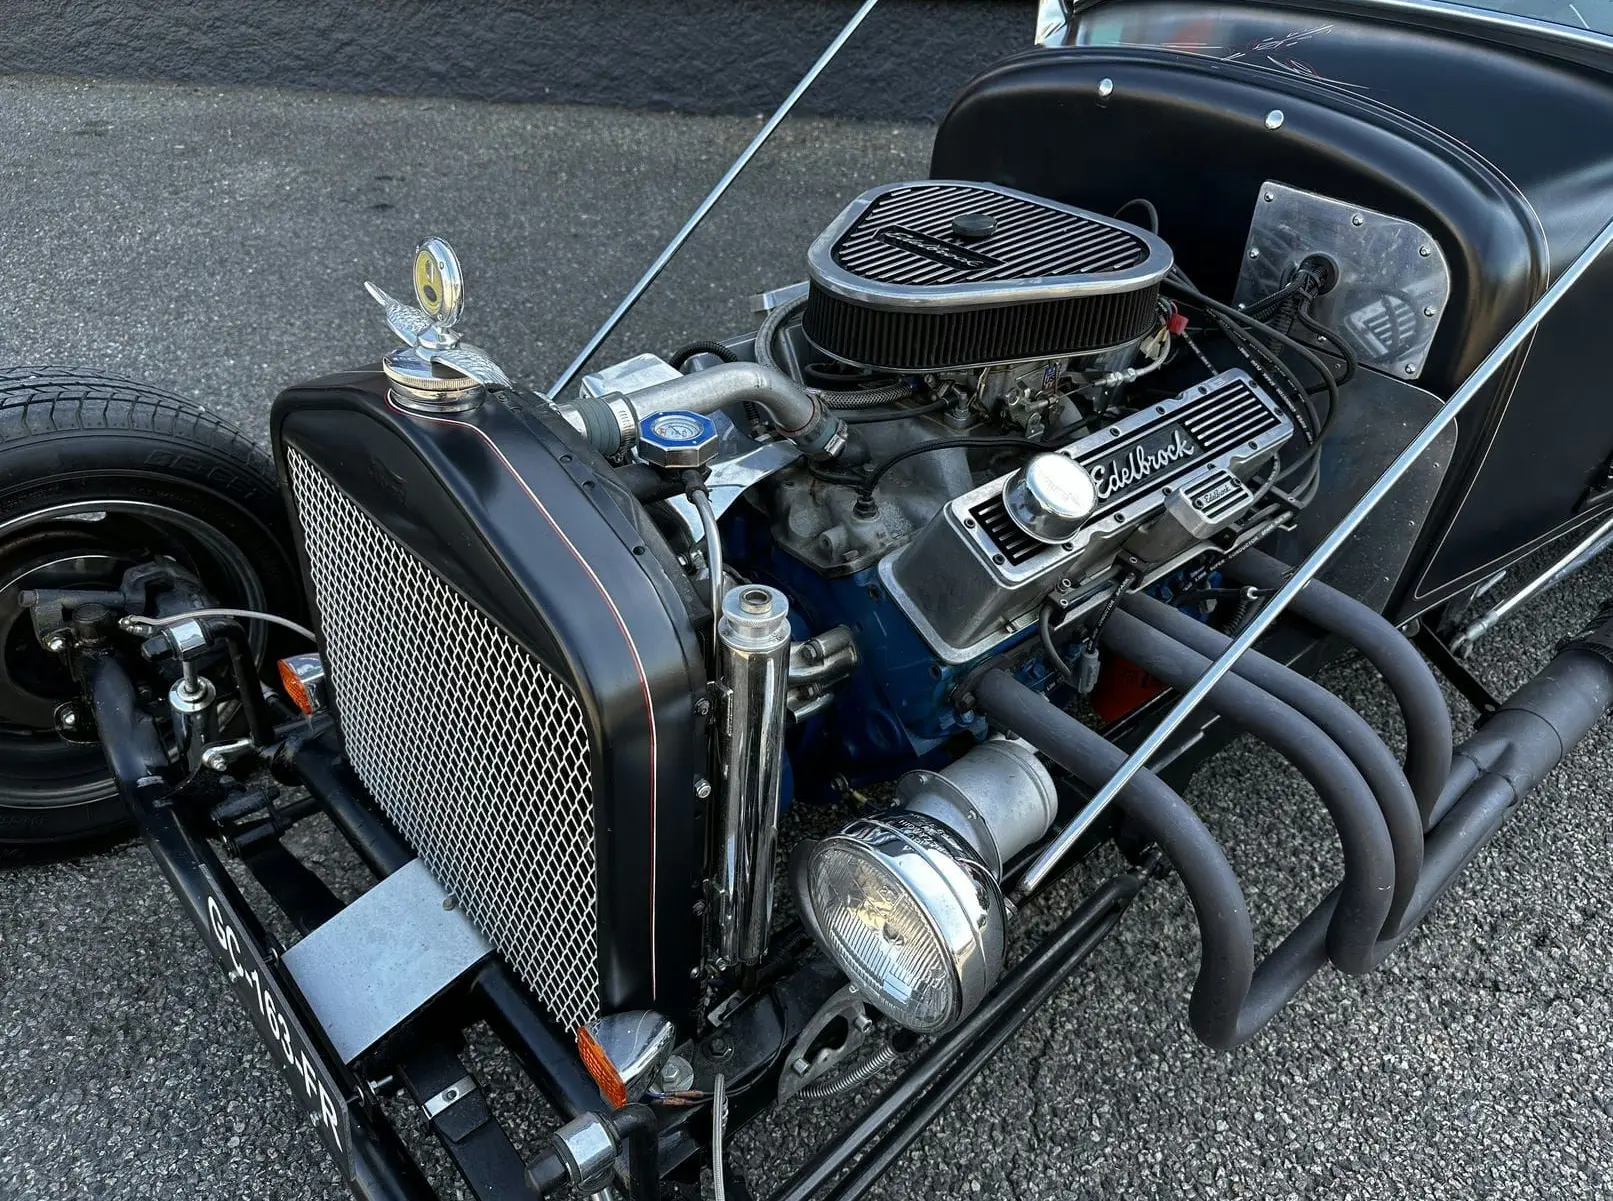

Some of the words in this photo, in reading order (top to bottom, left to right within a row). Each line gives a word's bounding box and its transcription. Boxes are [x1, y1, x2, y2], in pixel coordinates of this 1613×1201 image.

[1090, 430, 1194, 499] Edelbrock
[1203, 485, 1231, 503] Edelbrock
[208, 896, 342, 1153] GC-163-FR
